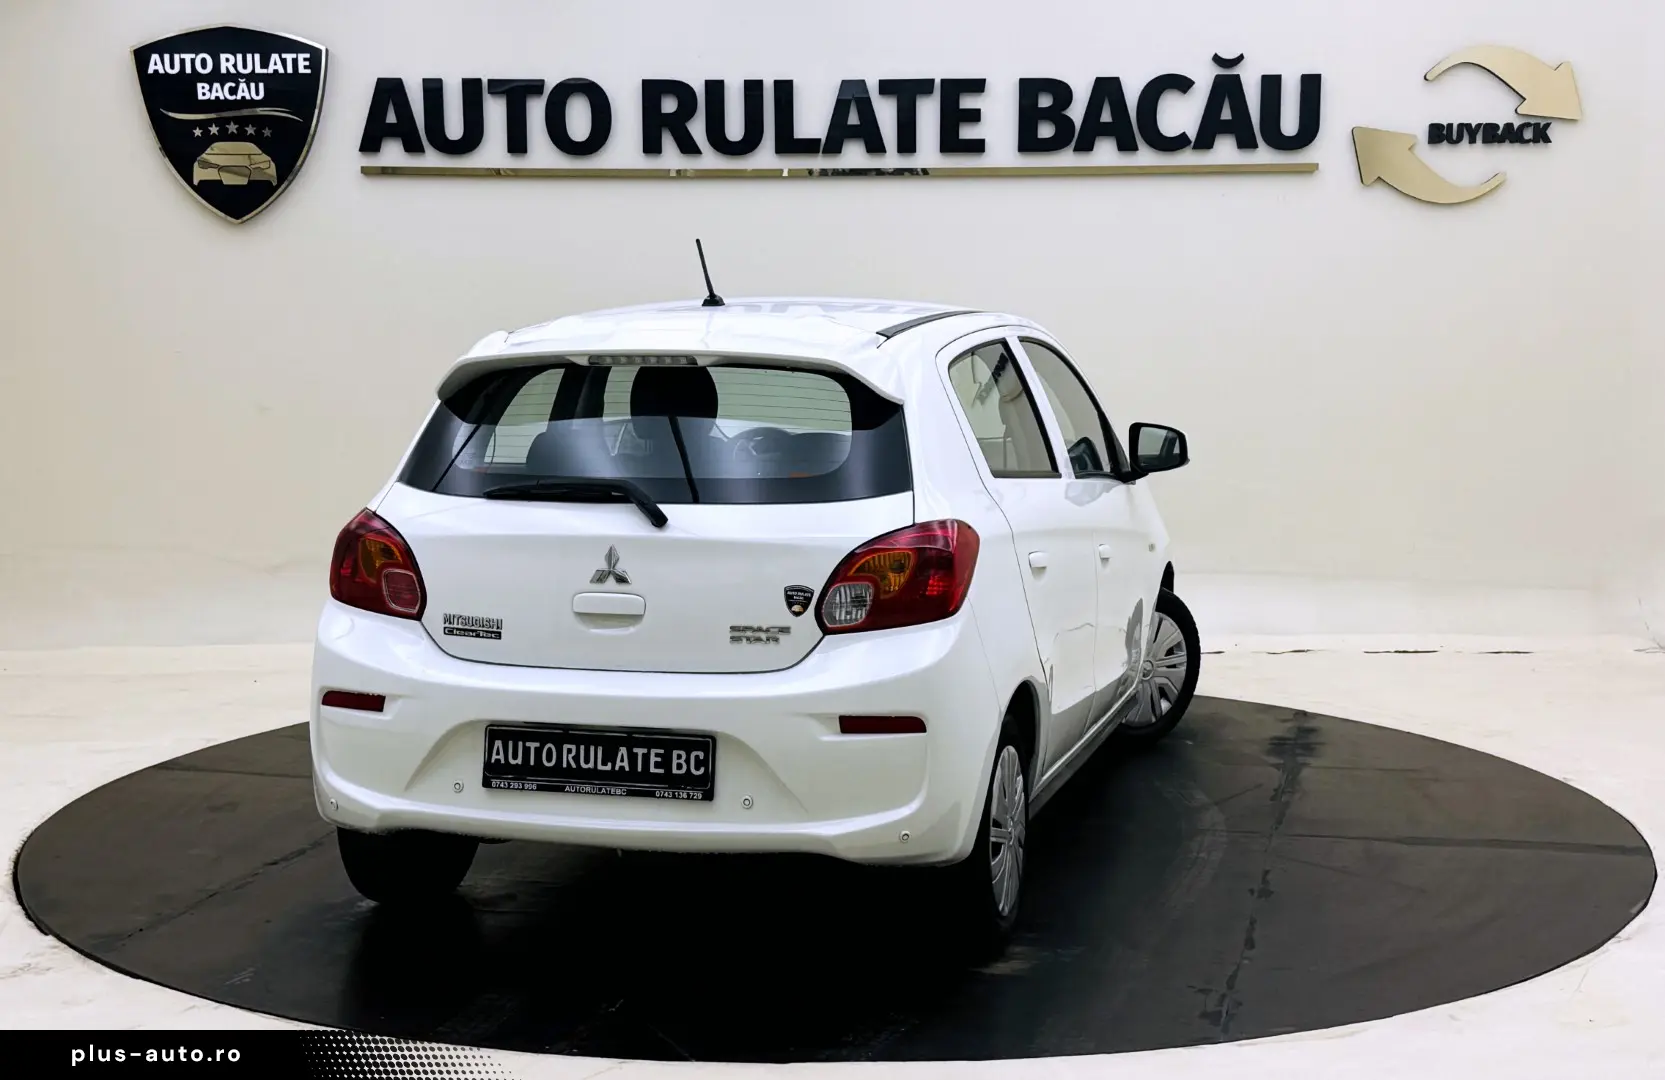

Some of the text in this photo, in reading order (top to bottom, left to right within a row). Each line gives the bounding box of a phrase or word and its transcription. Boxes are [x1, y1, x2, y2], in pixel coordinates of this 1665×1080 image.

[148, 53, 311, 75] AUTO RULATE
[196, 78, 265, 101] BACĂU
[358, 52, 1322, 156] AUTO RULATE BACĂU
[1427, 121, 1553, 145] BUYBACK
[671, 750, 705, 775] BC
[564, 785, 627, 795] AUTORULATEBC
[655, 790, 673, 798] 0743
[689, 792, 703, 800] 729
